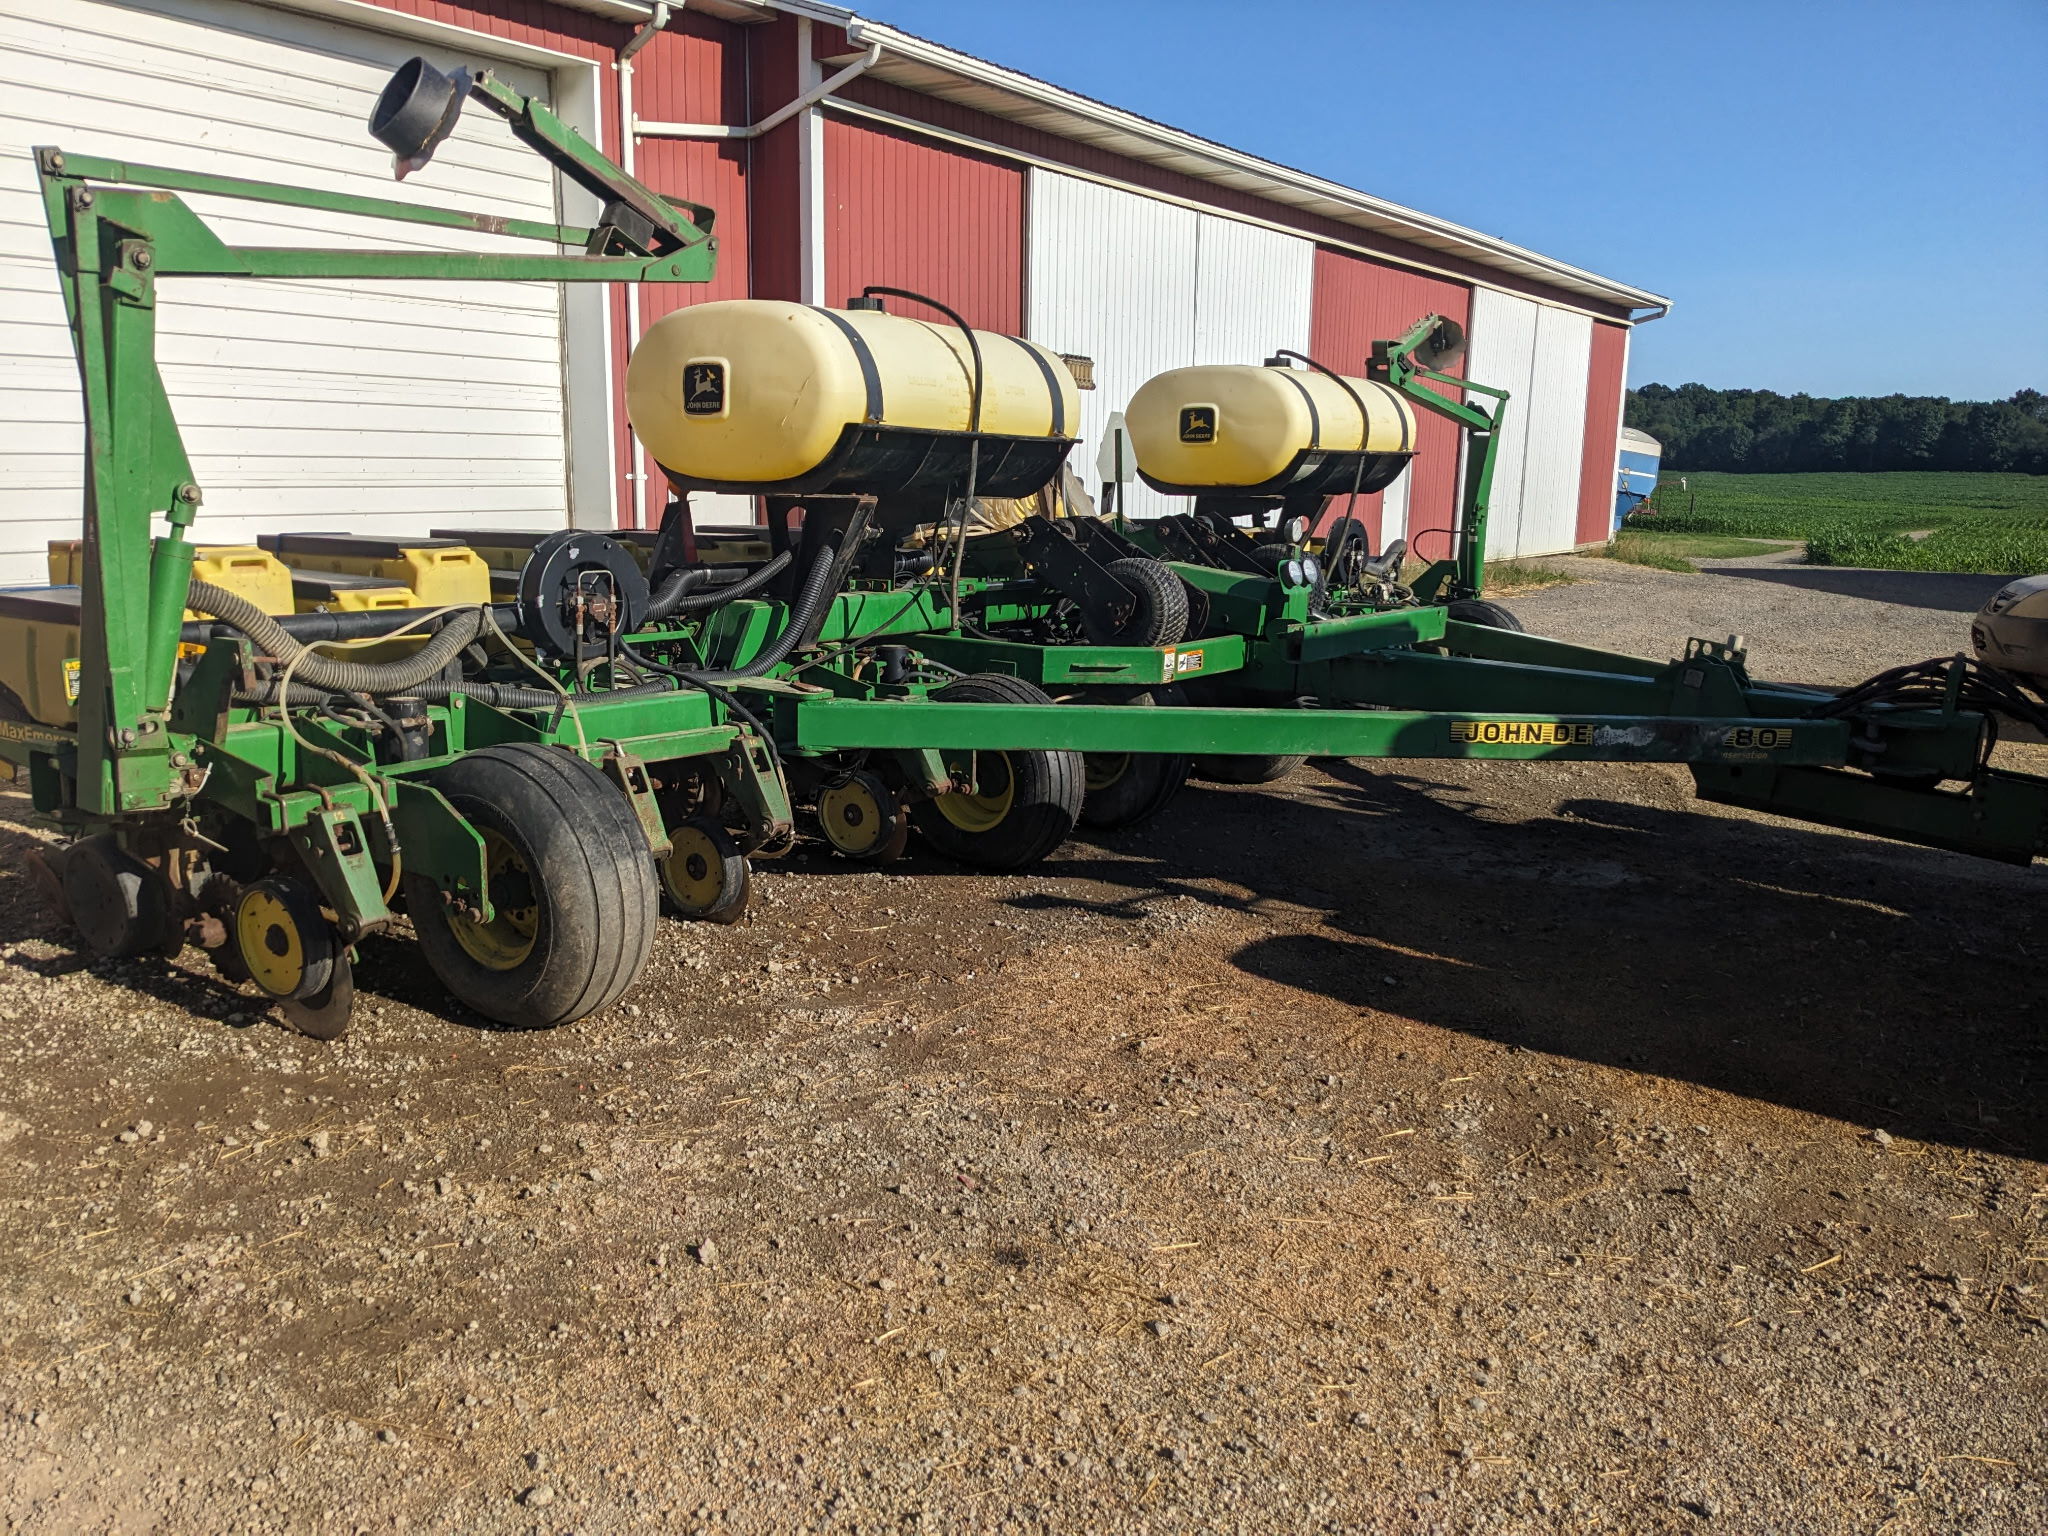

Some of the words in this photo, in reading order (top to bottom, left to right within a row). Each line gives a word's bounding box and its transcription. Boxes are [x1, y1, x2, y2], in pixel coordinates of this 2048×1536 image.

[687, 401, 701, 409] JOHN
[702, 401, 721, 409] DEERE
[1463, 723, 1543, 743] JOHN
[1734, 728, 1779, 748] 80
